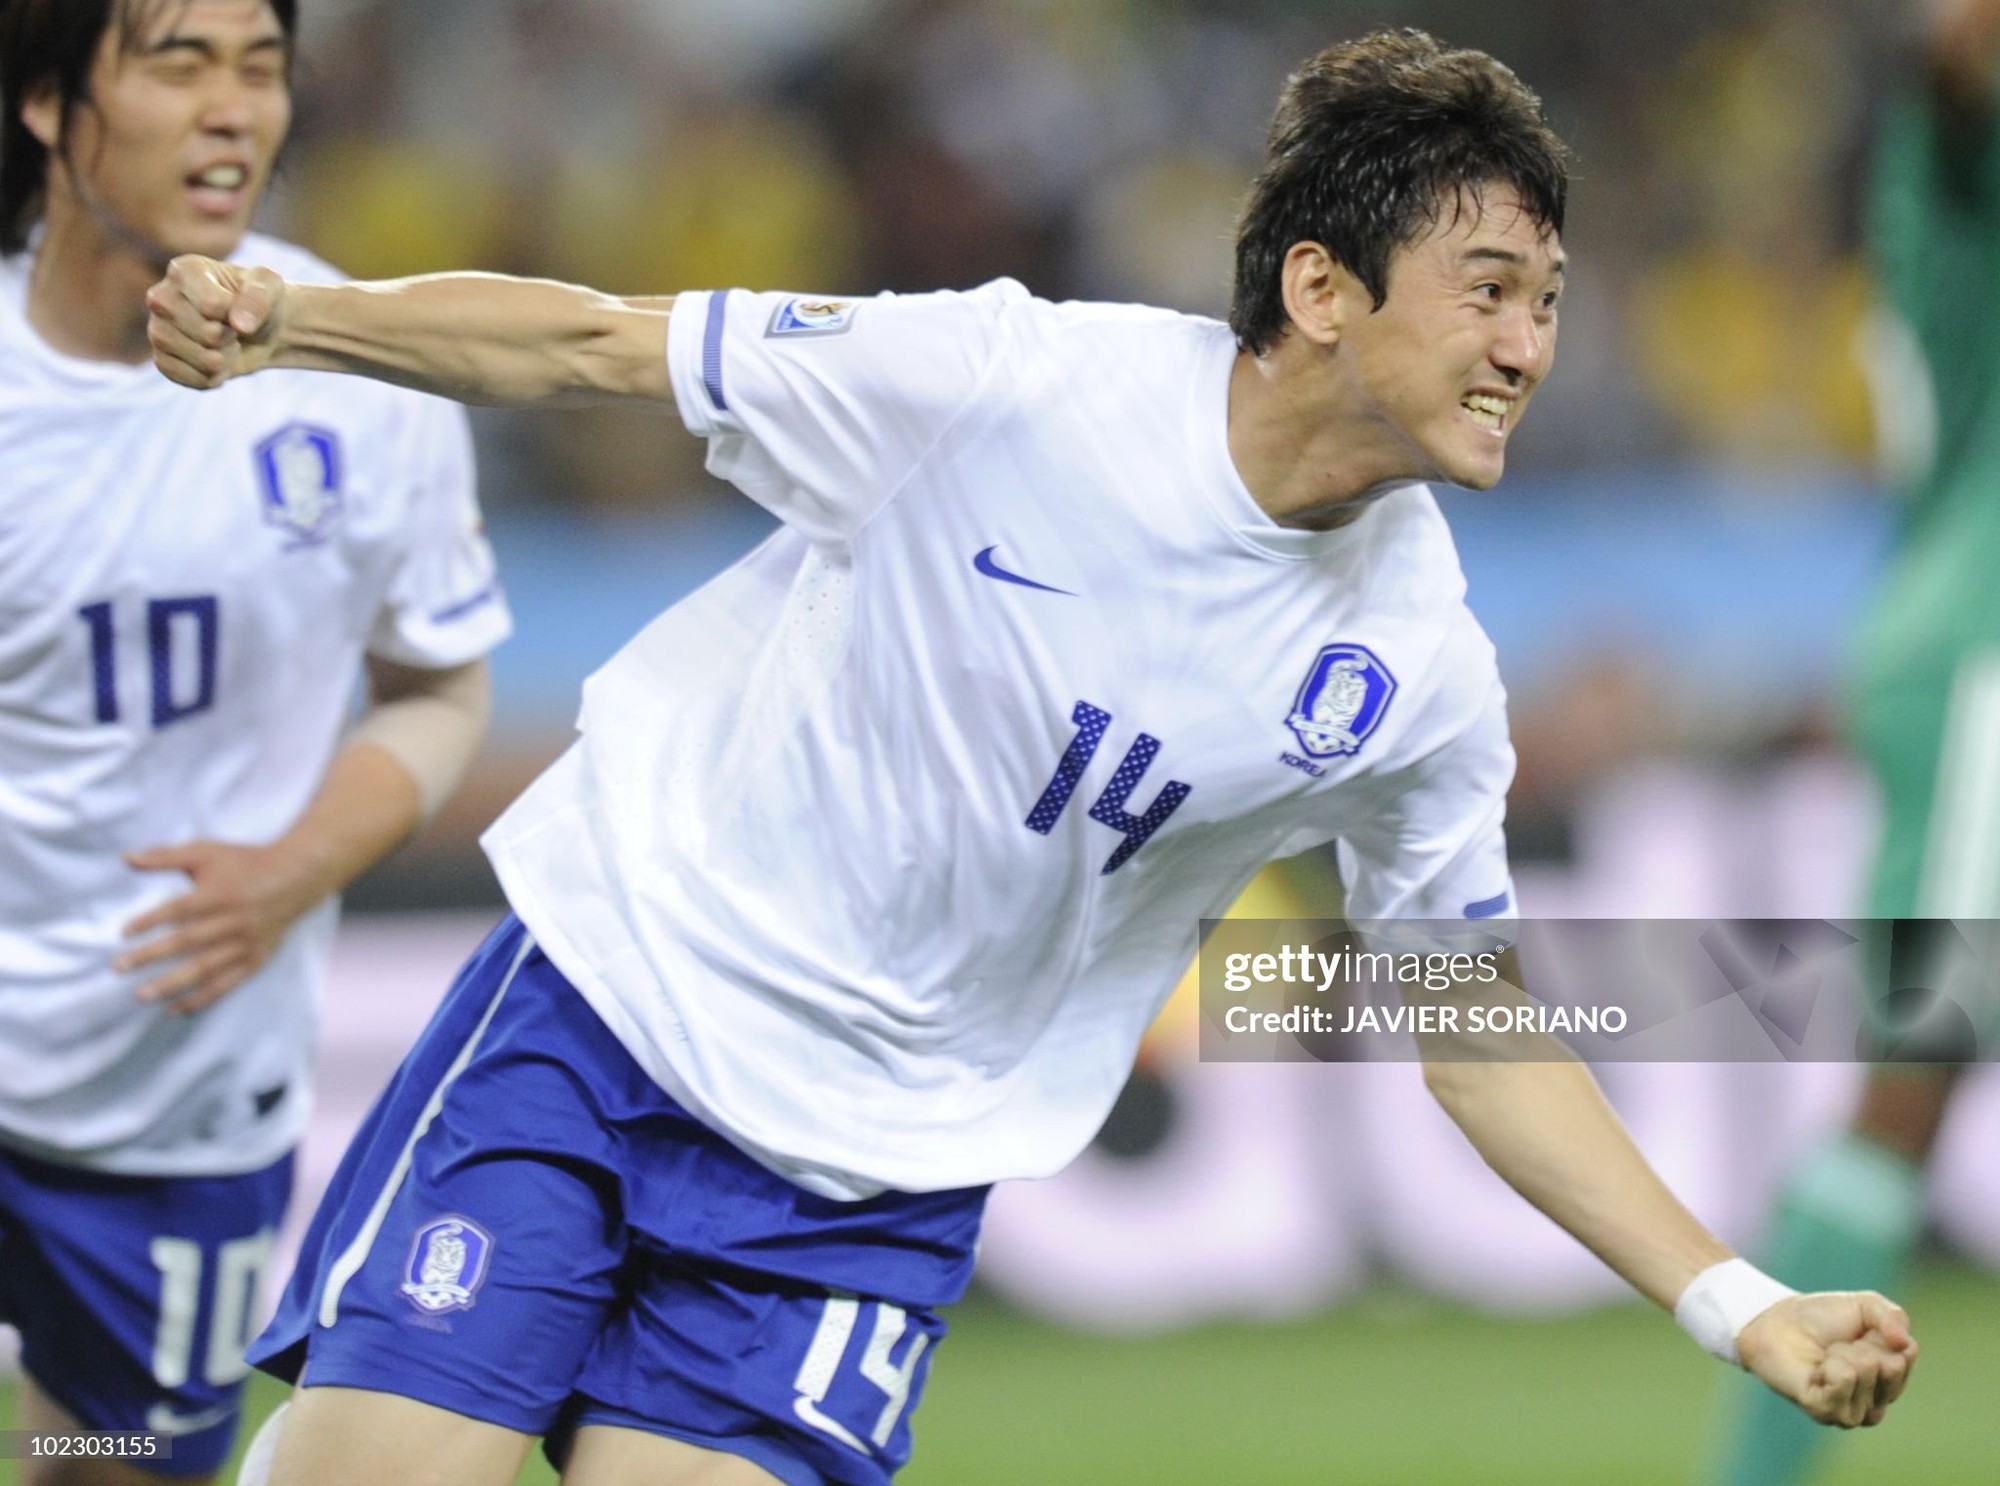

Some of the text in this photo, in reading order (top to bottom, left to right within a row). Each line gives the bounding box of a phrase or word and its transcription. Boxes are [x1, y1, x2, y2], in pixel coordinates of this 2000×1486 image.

[78, 596, 218, 729] 10
[1025, 699, 1192, 876] 14
[1278, 751, 1328, 778] KOREA
[793, 1297, 929, 1449] 14
